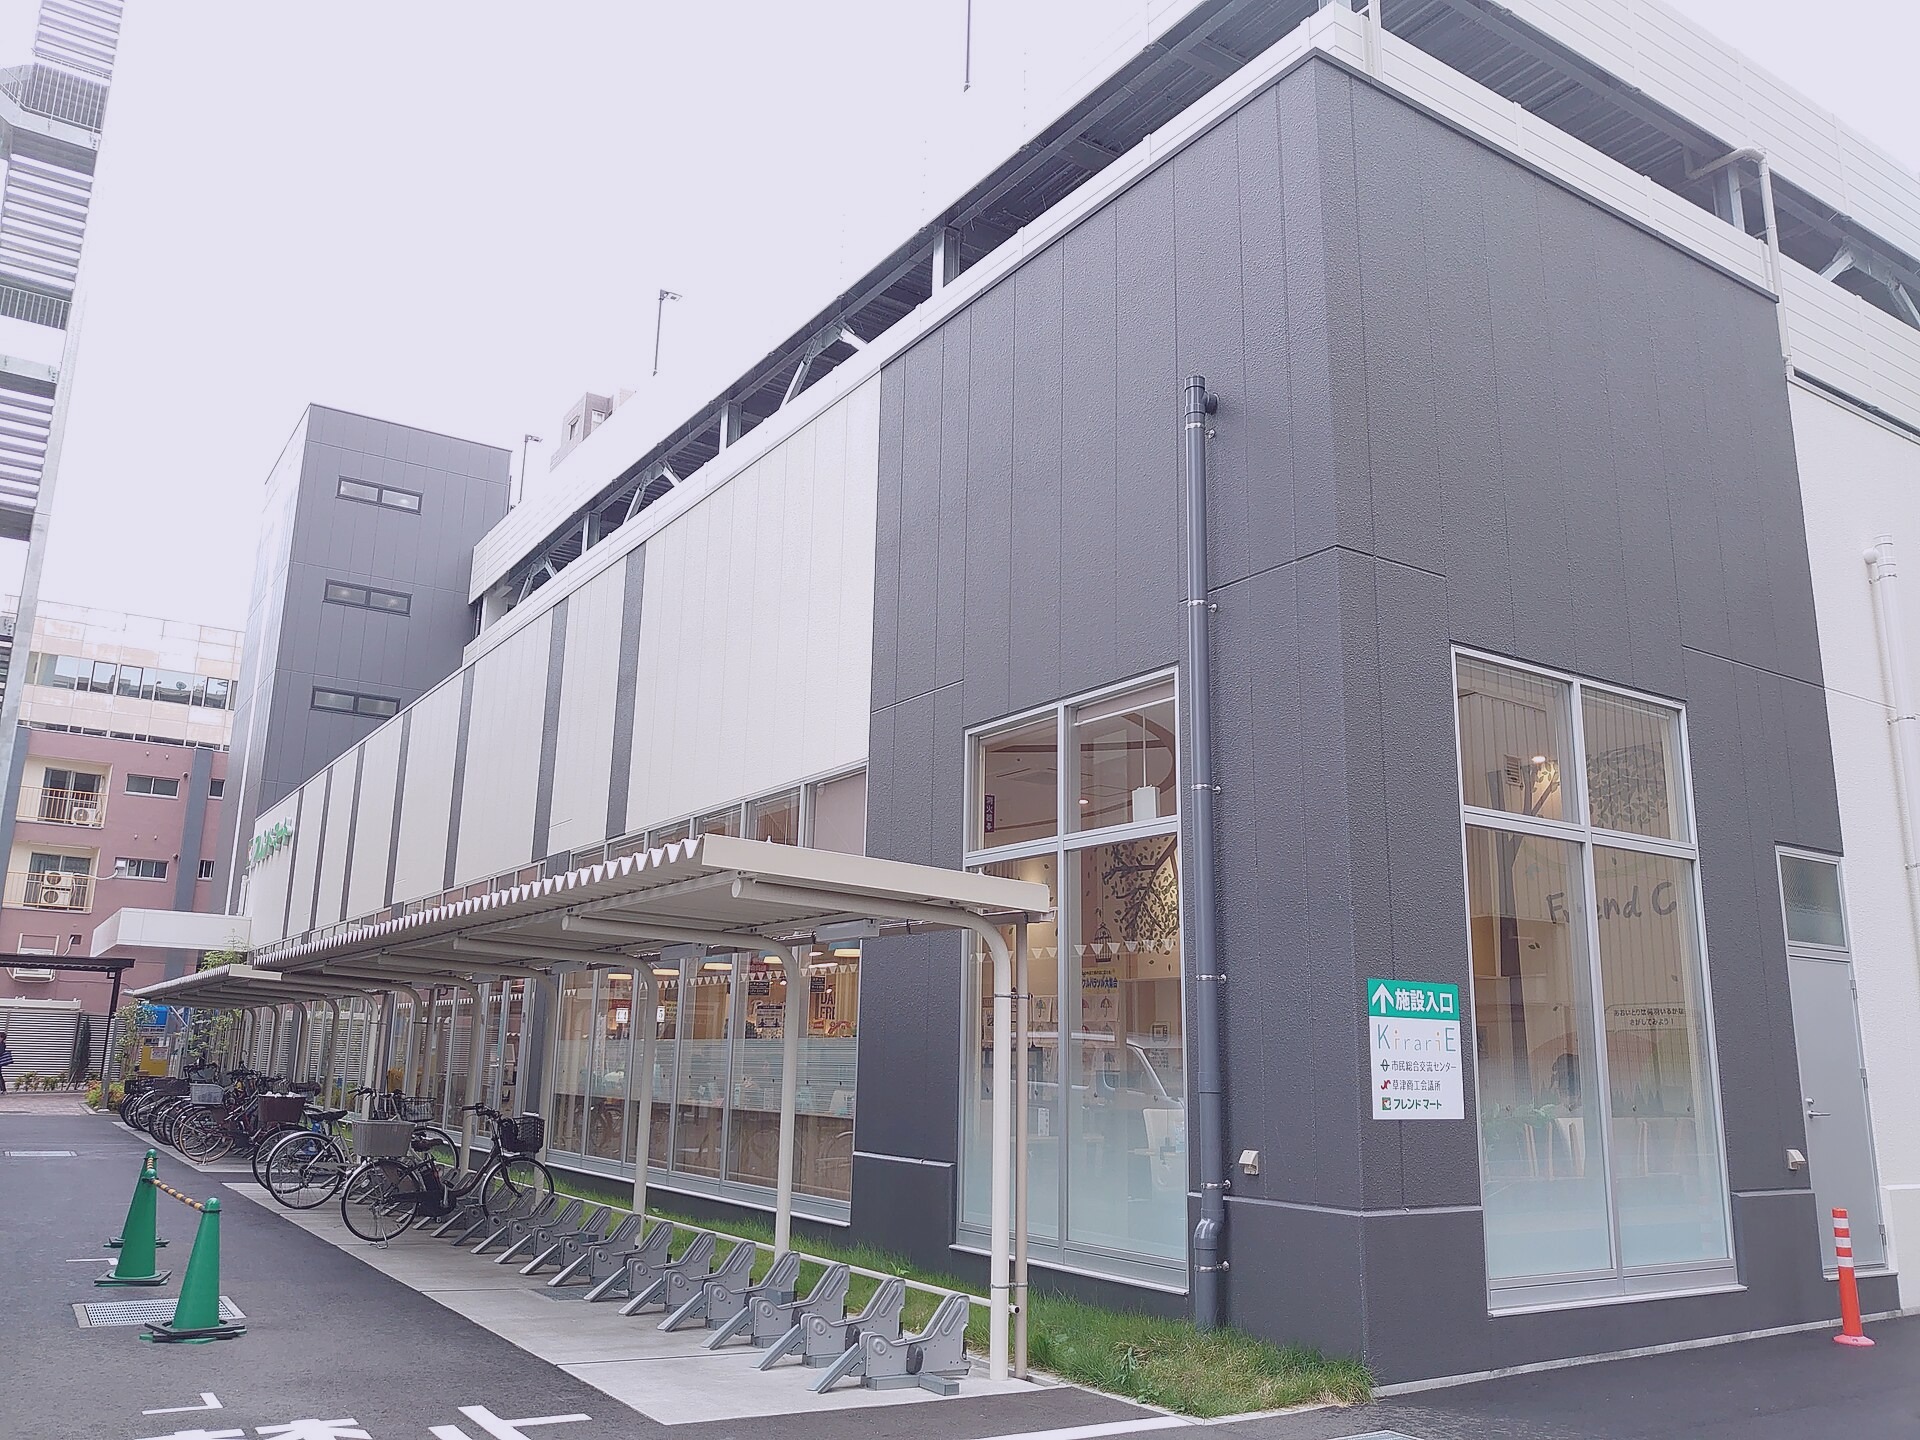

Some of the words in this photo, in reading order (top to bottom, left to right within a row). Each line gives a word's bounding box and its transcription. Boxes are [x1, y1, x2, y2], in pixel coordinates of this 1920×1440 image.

[1395, 988, 1454, 1014] 施設入口
[1377, 1023, 1457, 1053] KirariE
[1391, 1060, 1457, 1073] 市民総合交流センター
[1392, 1079, 1442, 1091] 草津商工会議所
[1393, 1098, 1443, 1111] フレンドマート
